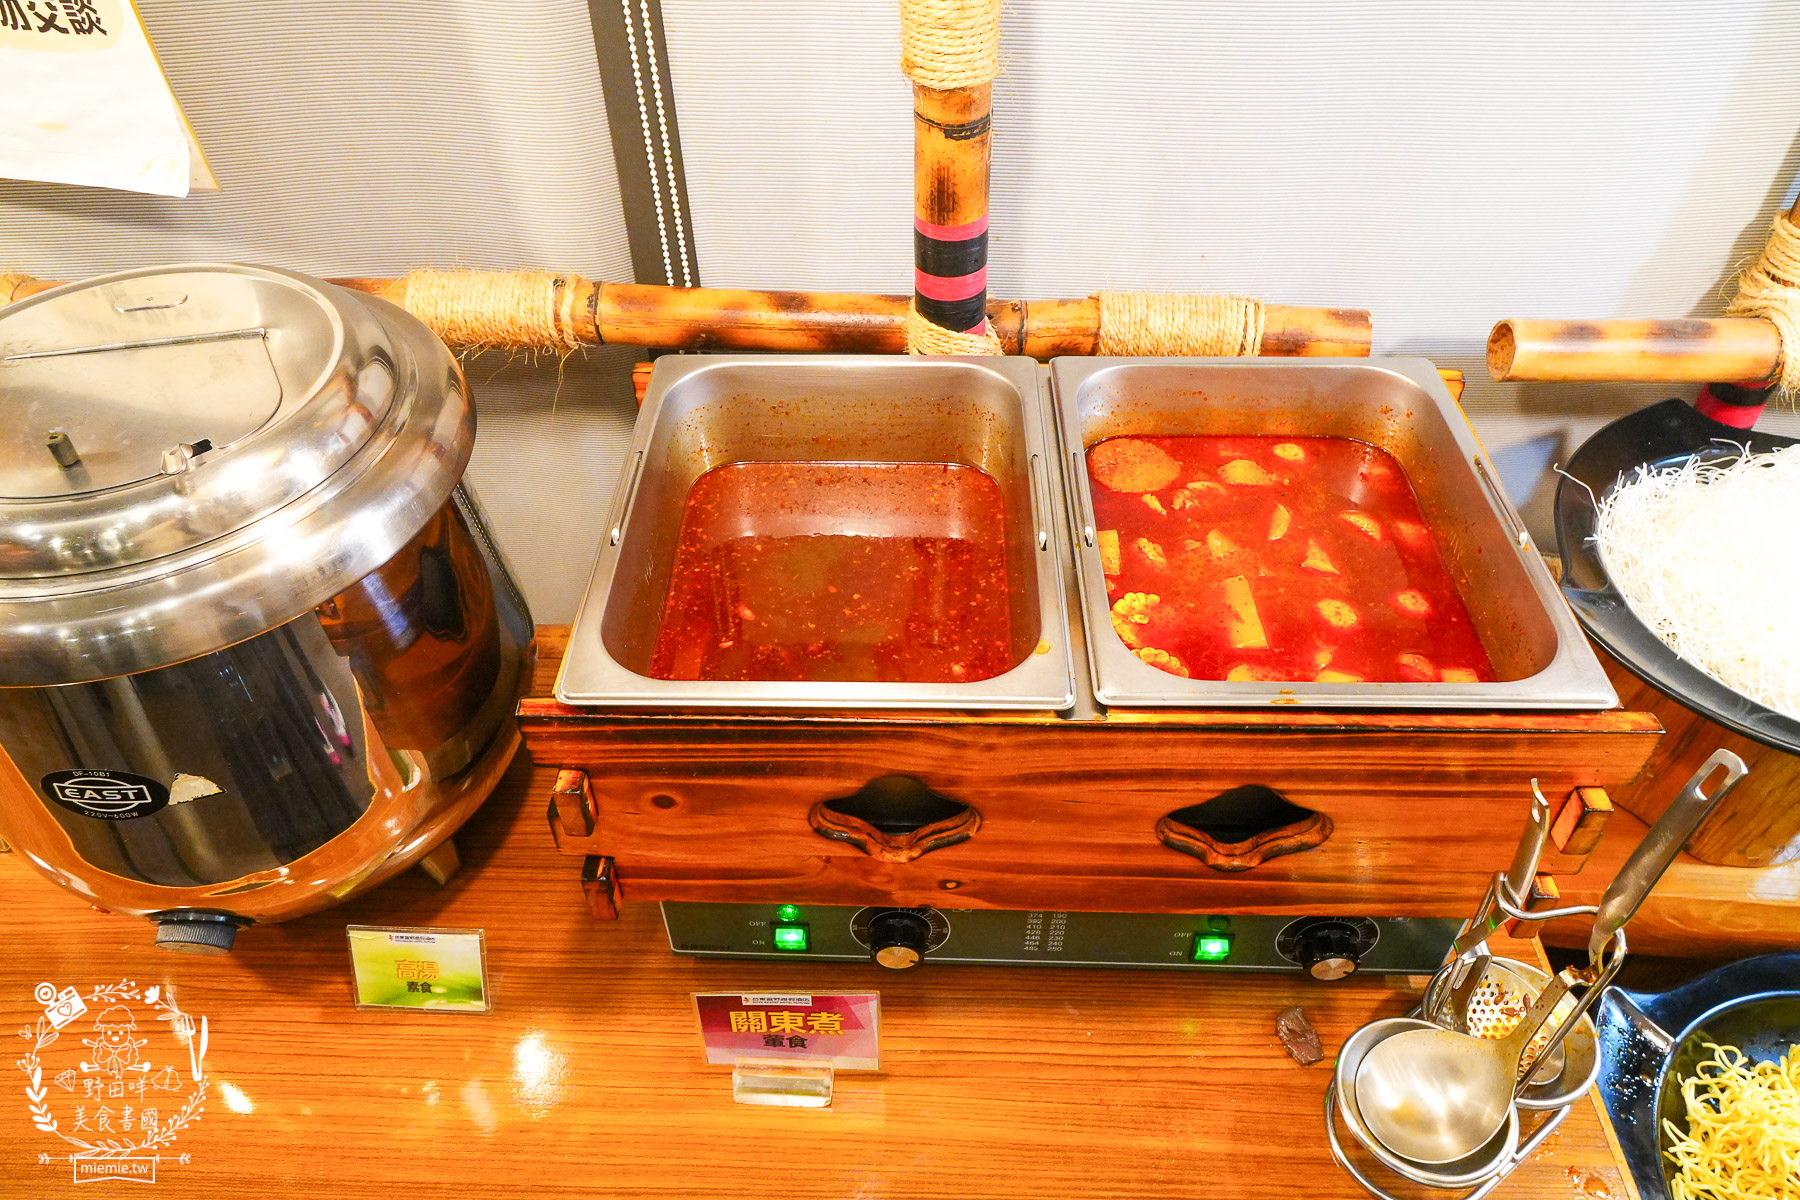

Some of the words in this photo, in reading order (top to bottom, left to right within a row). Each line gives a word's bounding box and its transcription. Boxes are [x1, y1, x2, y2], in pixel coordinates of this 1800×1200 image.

[64, 788, 138, 800] EAST
[395, 960, 440, 981] 高湯
[406, 981, 433, 994] 素食
[729, 1010, 844, 1035] 關東煮
[762, 1034, 808, 1049] 葷食
